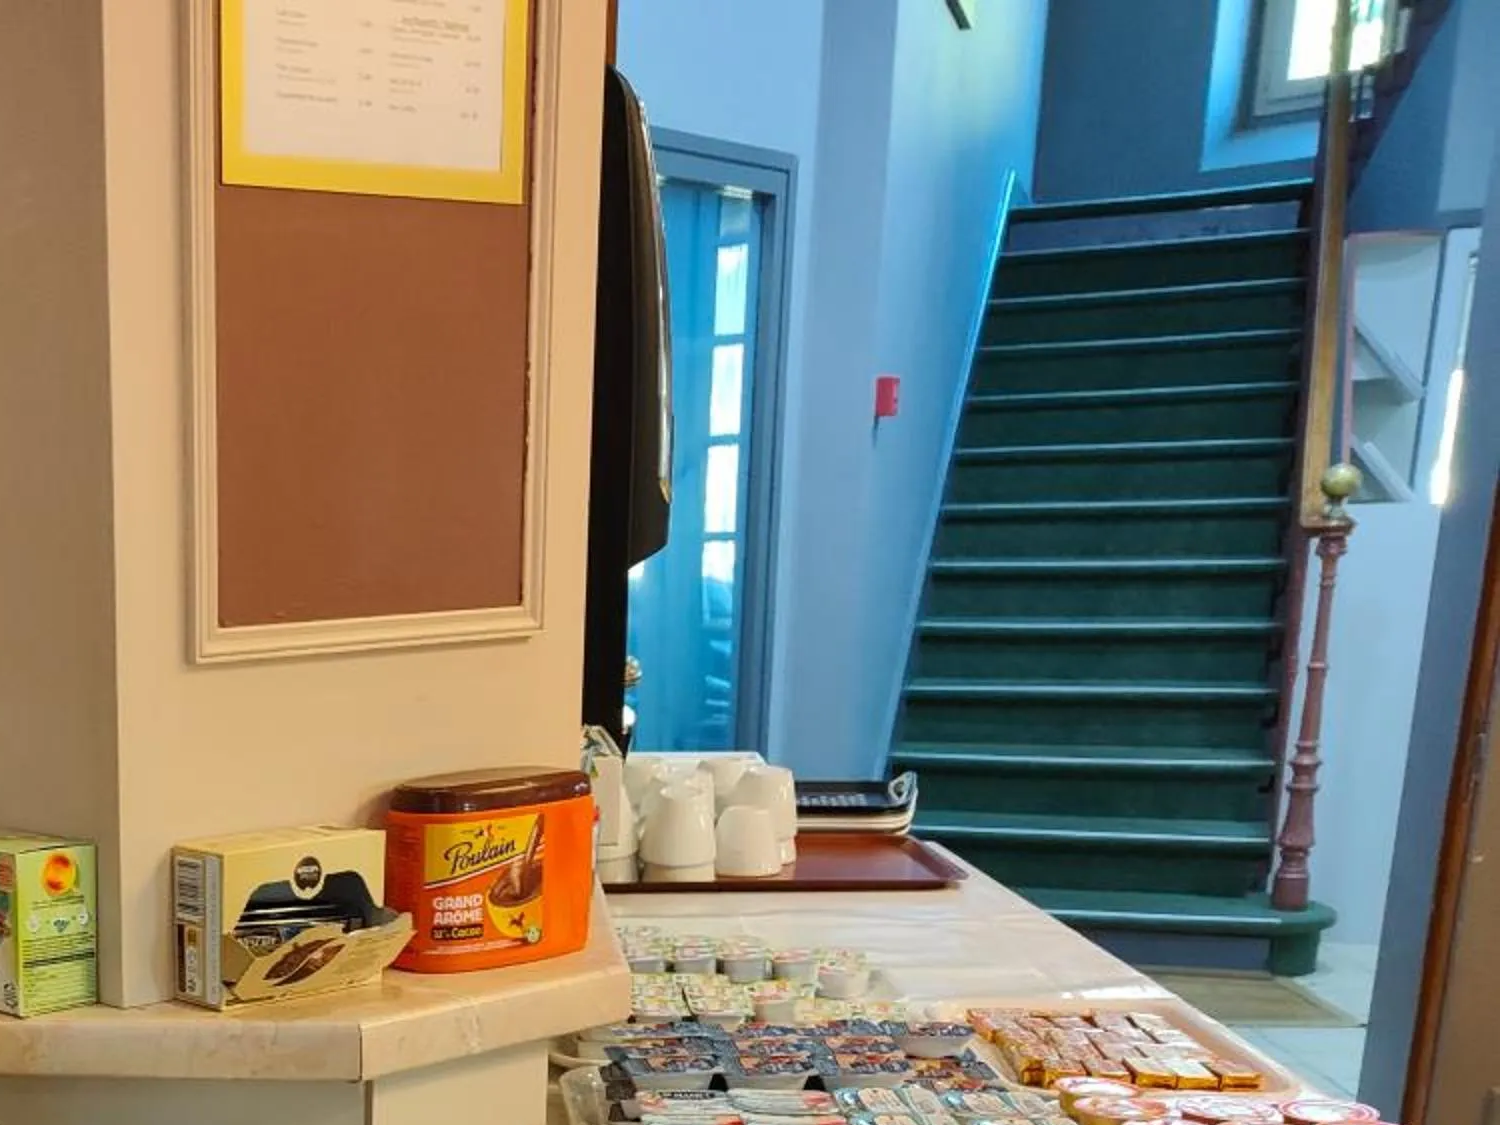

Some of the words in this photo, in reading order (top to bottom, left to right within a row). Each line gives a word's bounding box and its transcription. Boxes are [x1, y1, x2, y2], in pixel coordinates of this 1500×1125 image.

[443, 840, 516, 875] Poulain
[432, 894, 483, 910] GRAND
[452, 928, 483, 938] Cacao
